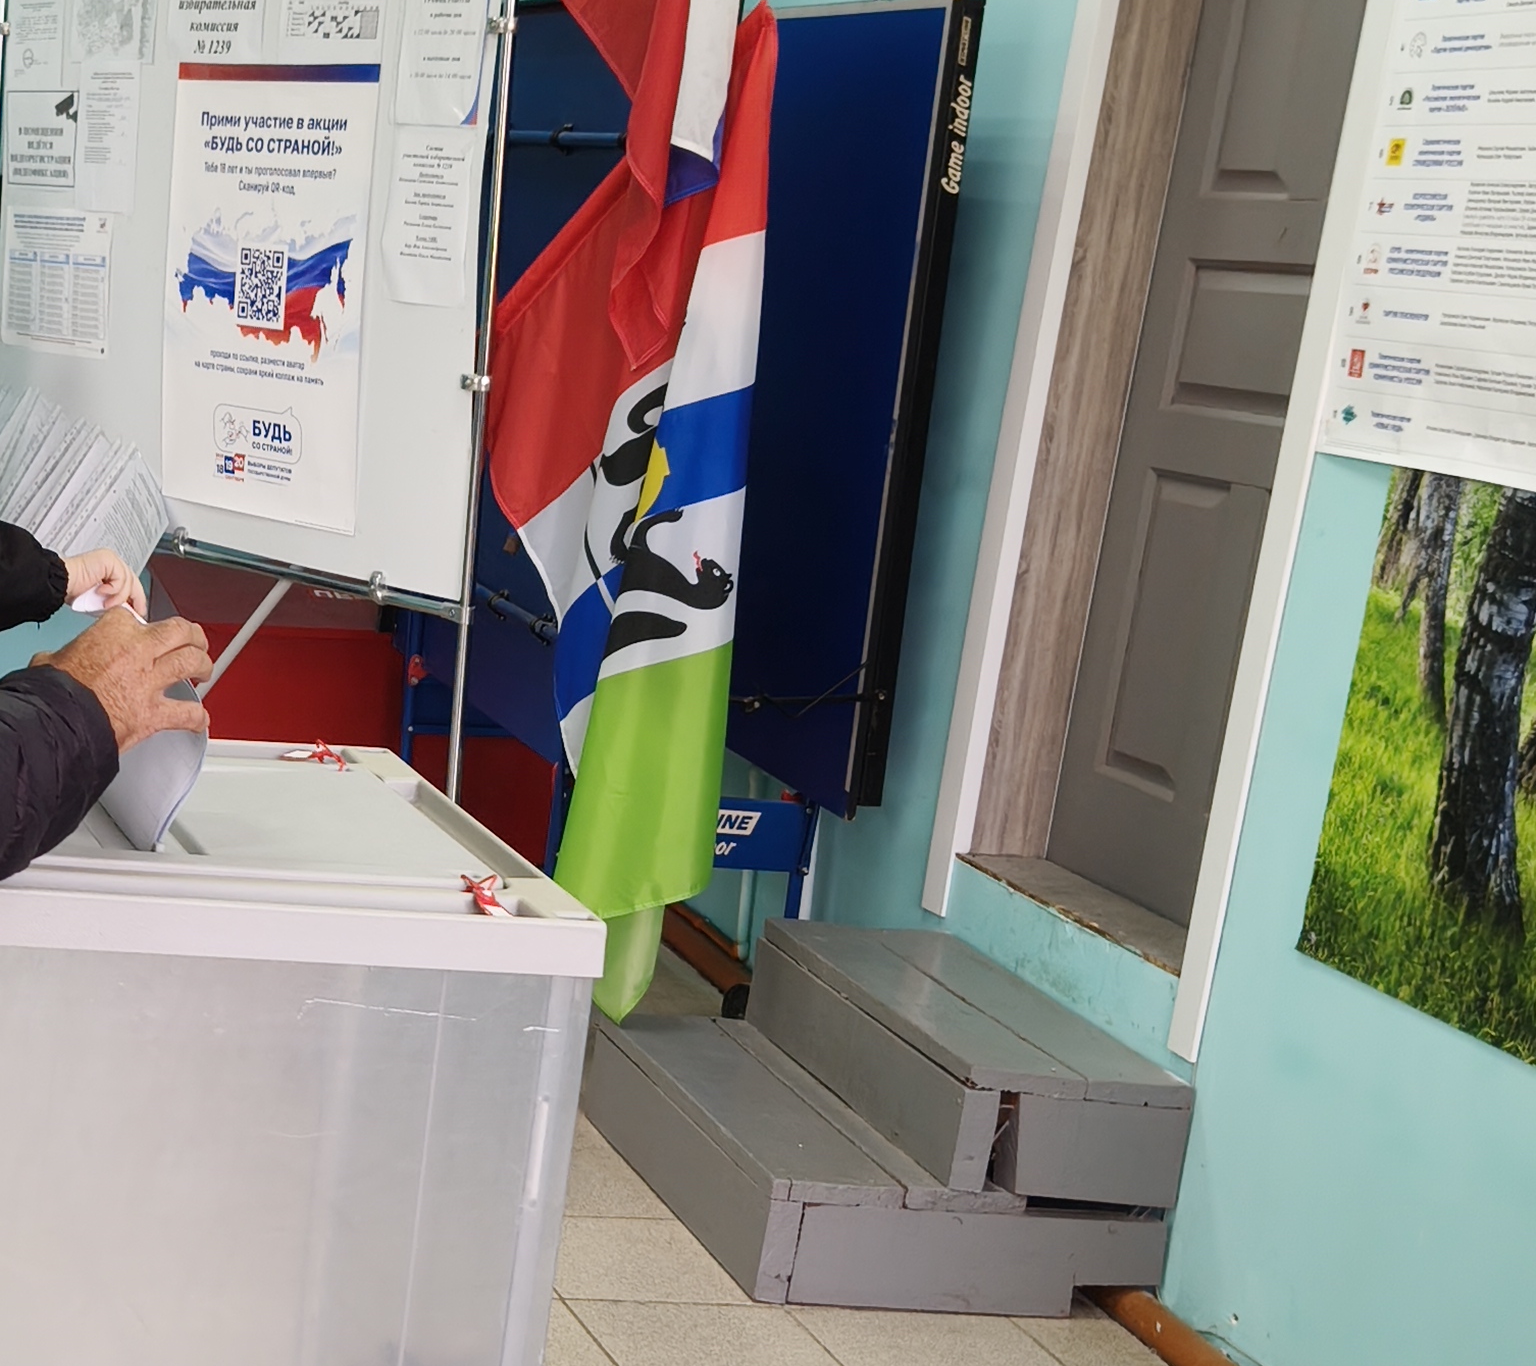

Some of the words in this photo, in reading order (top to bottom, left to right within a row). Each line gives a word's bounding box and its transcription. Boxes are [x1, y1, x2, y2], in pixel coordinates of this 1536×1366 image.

[189, 20, 239, 32] комиссия
[194, 39, 205, 54] №
[207, 40, 232, 54] 1239
[948, 75, 973, 137] indoor
[201, 111, 241, 130] Прими
[244, 116, 294, 131] участие
[297, 117, 304, 129] в
[307, 118, 347, 133] акции
[204, 136, 243, 154] «БУДЬ
[246, 137, 264, 153] СО
[267, 136, 342, 156] СТРАНОЙ!»
[204, 162, 218, 173] Тебе
[254, 166, 301, 178] проголосовал
[941, 140, 965, 195] Game
[238, 180, 269, 194] Сканируй
[252, 419, 292, 444] БУДЬ
[252, 441, 261, 450] СО
[262, 443, 293, 456] СТРАНОЙ!
[216, 464, 224, 474] 18
[718, 814, 753, 830] INE
